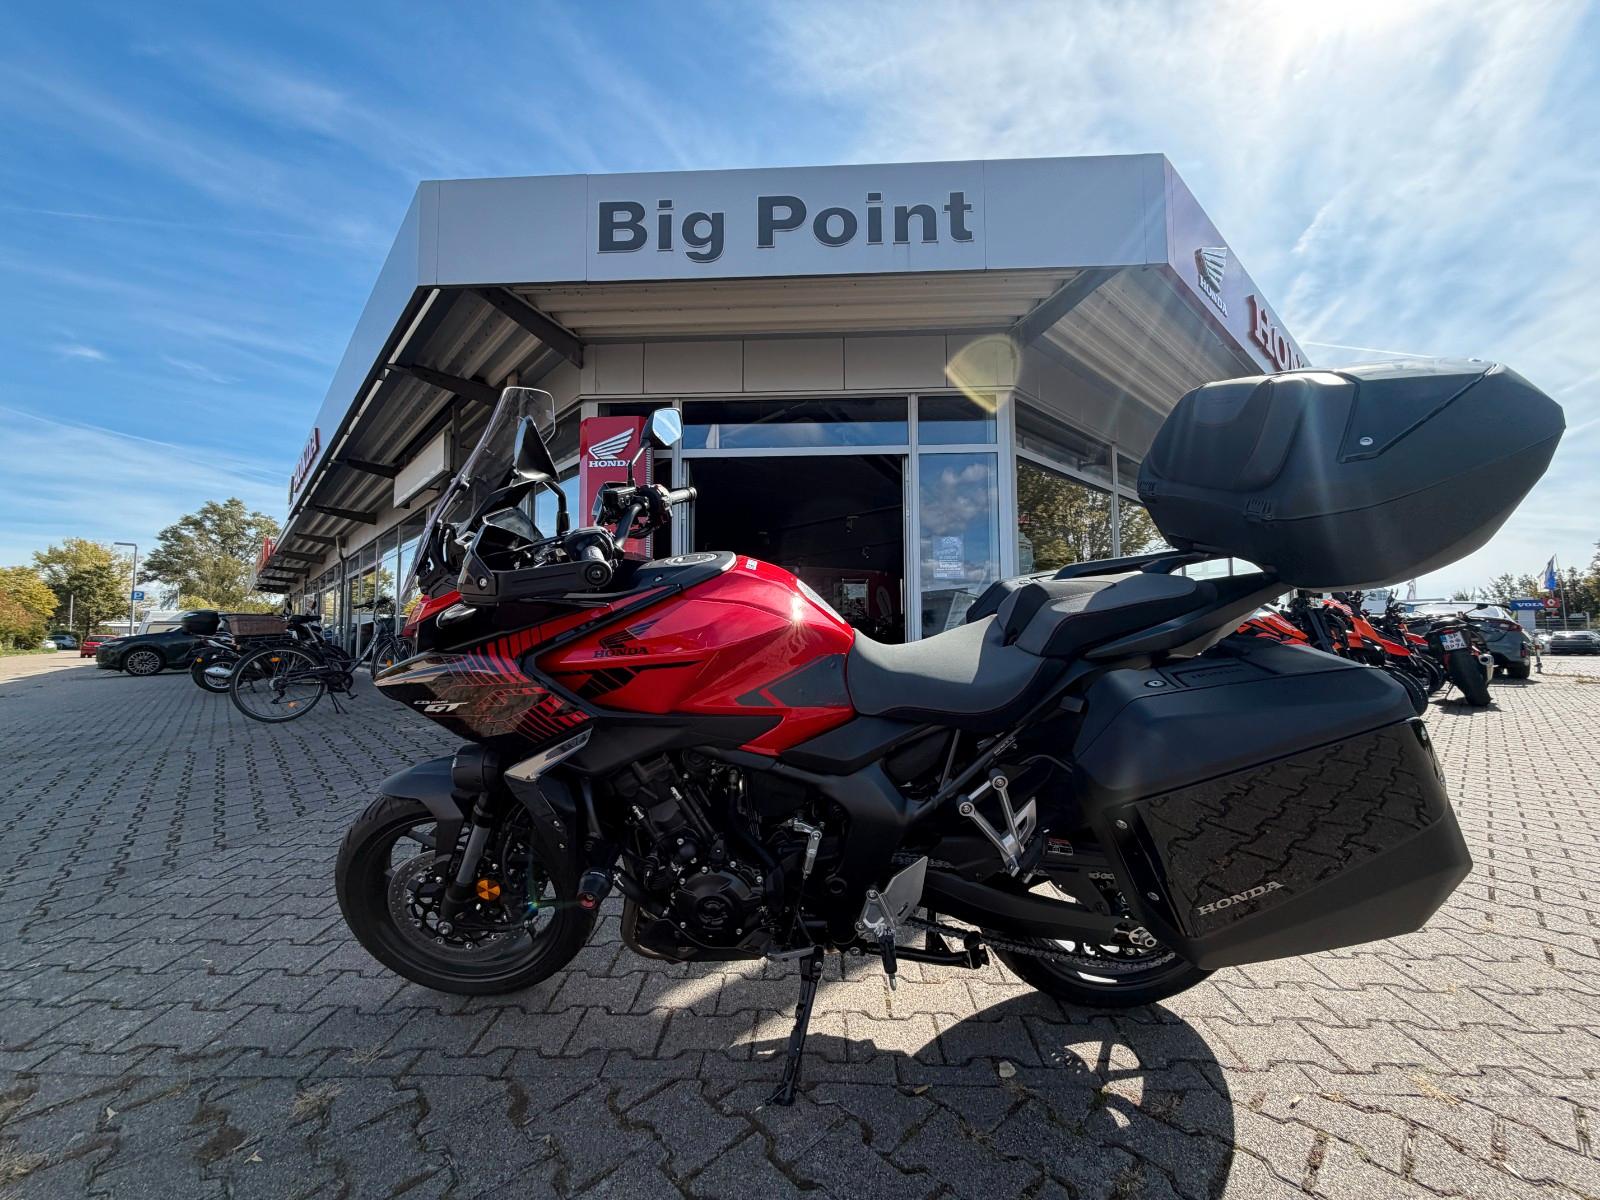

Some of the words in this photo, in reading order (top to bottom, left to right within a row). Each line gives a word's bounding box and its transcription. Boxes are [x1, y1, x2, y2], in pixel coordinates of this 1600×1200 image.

[598, 199, 726, 264] Big
[756, 191, 975, 248] Point
[1199, 274, 1228, 317] HONDA
[592, 646, 650, 658] HONDA
[424, 701, 470, 712] GT
[1197, 881, 1284, 915] HONDA
